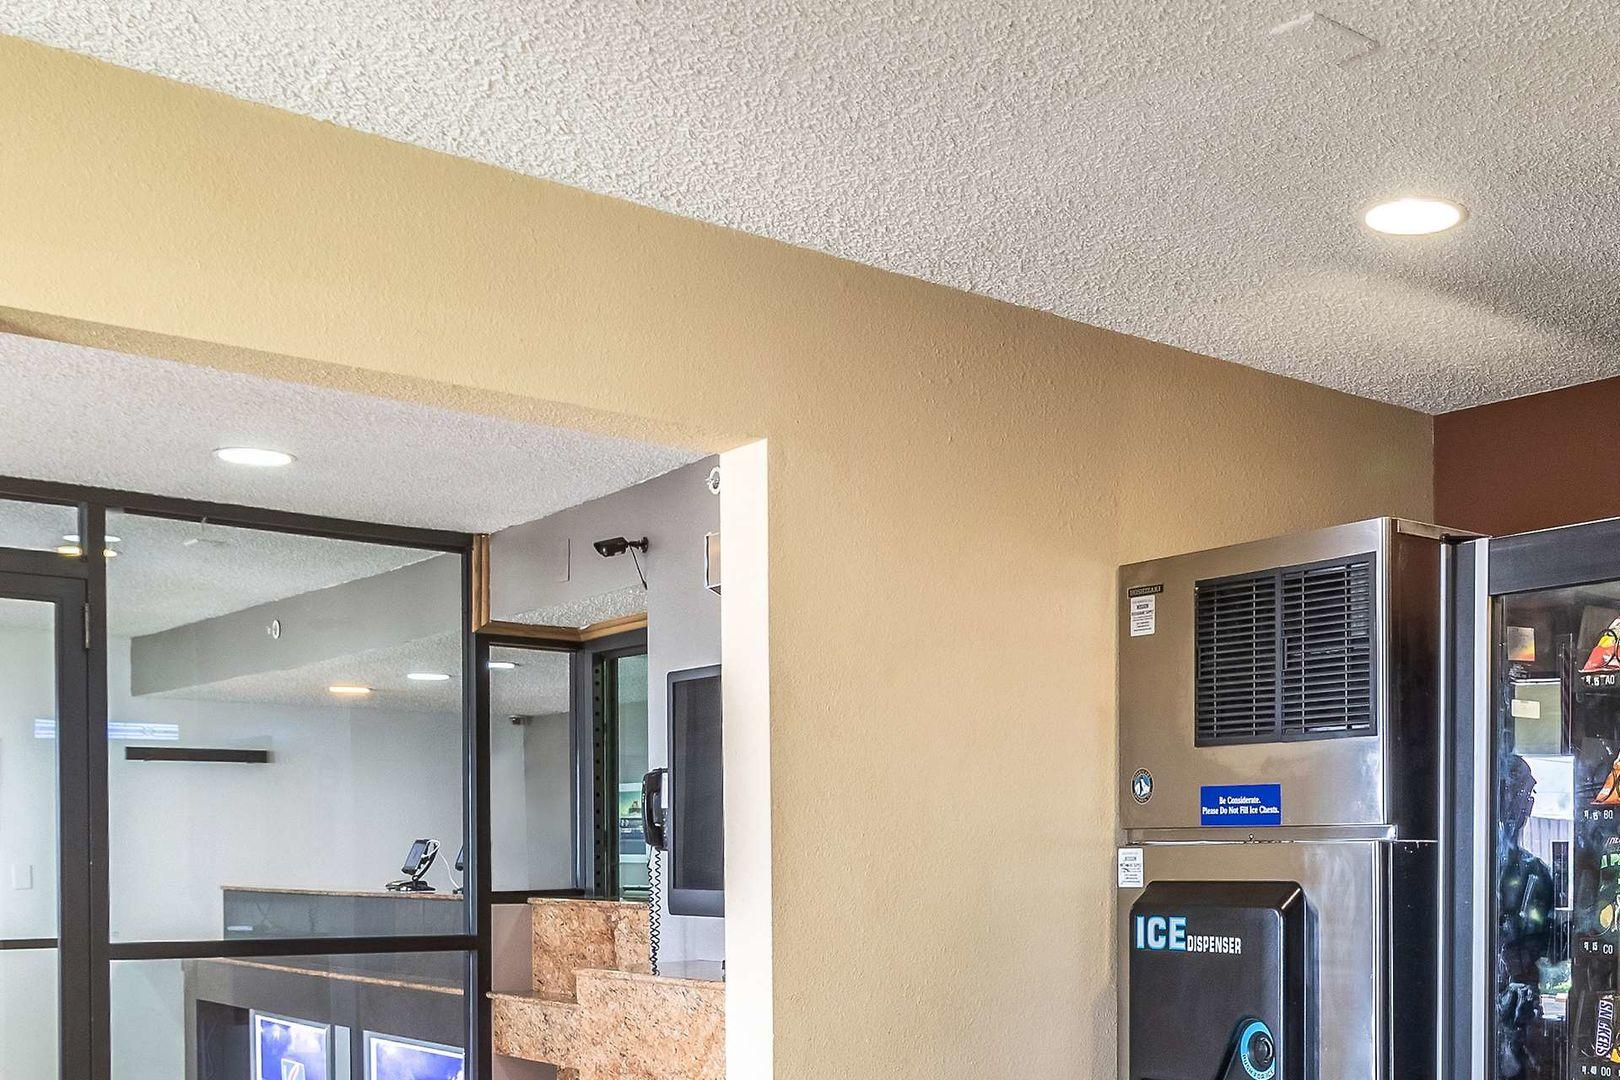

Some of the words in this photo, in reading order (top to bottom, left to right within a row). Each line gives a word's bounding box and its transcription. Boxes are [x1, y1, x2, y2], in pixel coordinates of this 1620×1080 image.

[1219, 796, 1226, 805] Be
[1227, 796, 1261, 805] Considerate.
[1202, 806, 1219, 815] Please
[1228, 806, 1239, 814] Not
[1250, 806, 1258, 814] Ice
[1136, 915, 1187, 951] ICE
[1187, 935, 1241, 955] DISPENSER
